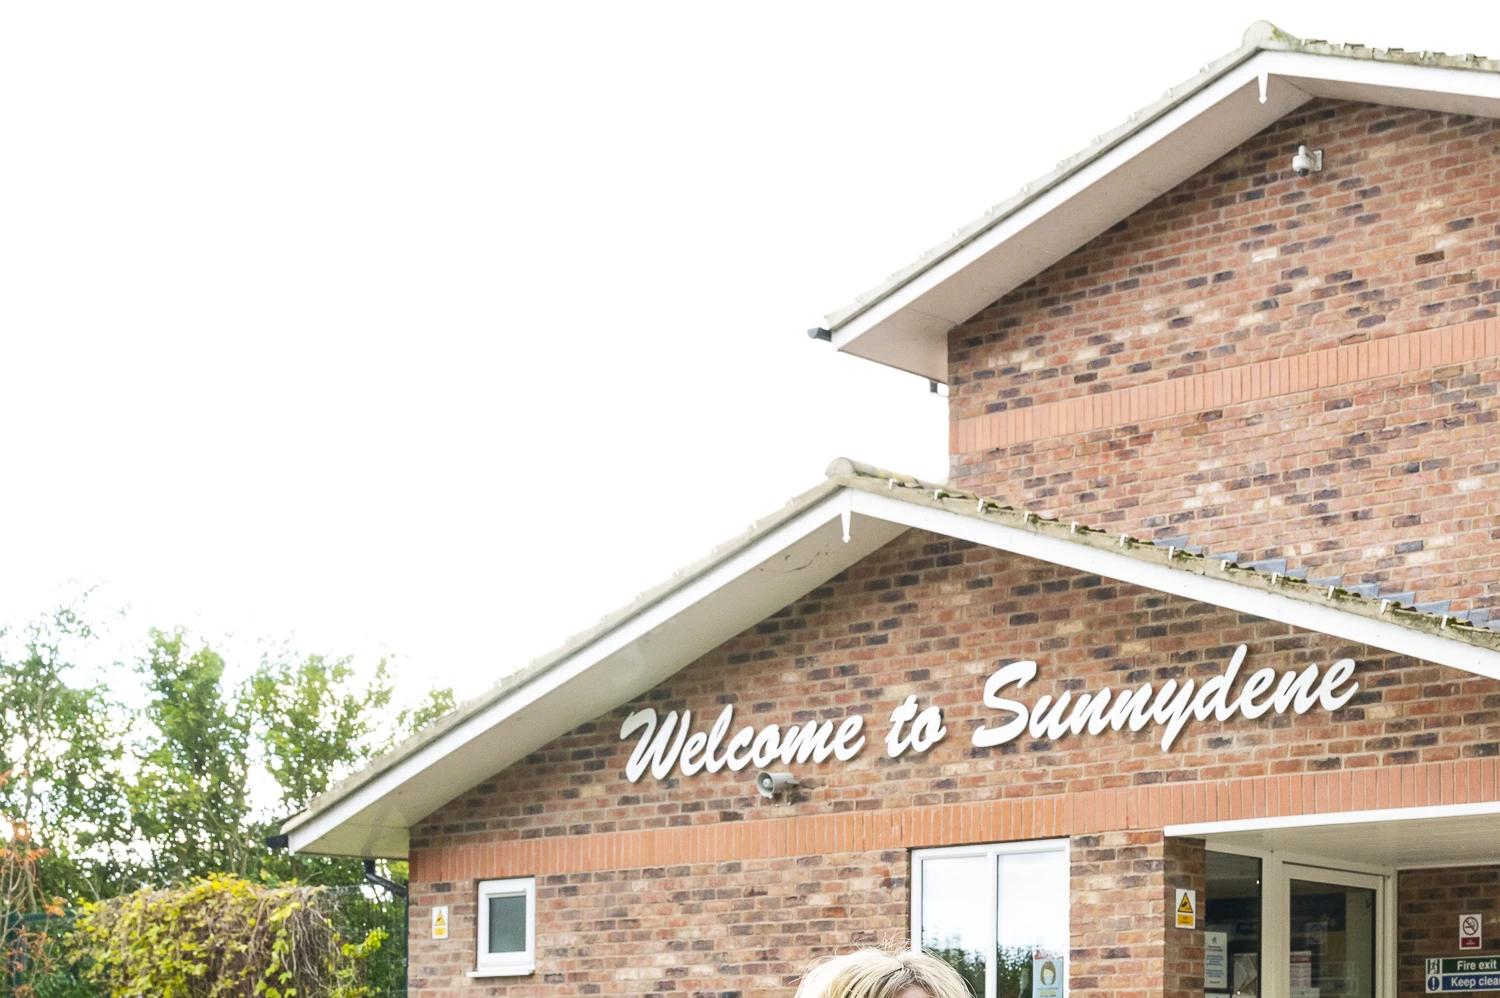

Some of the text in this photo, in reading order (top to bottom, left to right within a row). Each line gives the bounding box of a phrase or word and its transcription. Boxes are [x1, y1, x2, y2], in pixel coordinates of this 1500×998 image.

[619, 643, 1361, 783] Welcome to Sunnydene
[1457, 959, 1497, 971] Fire exit
[1451, 976, 1476, 989] Keep
